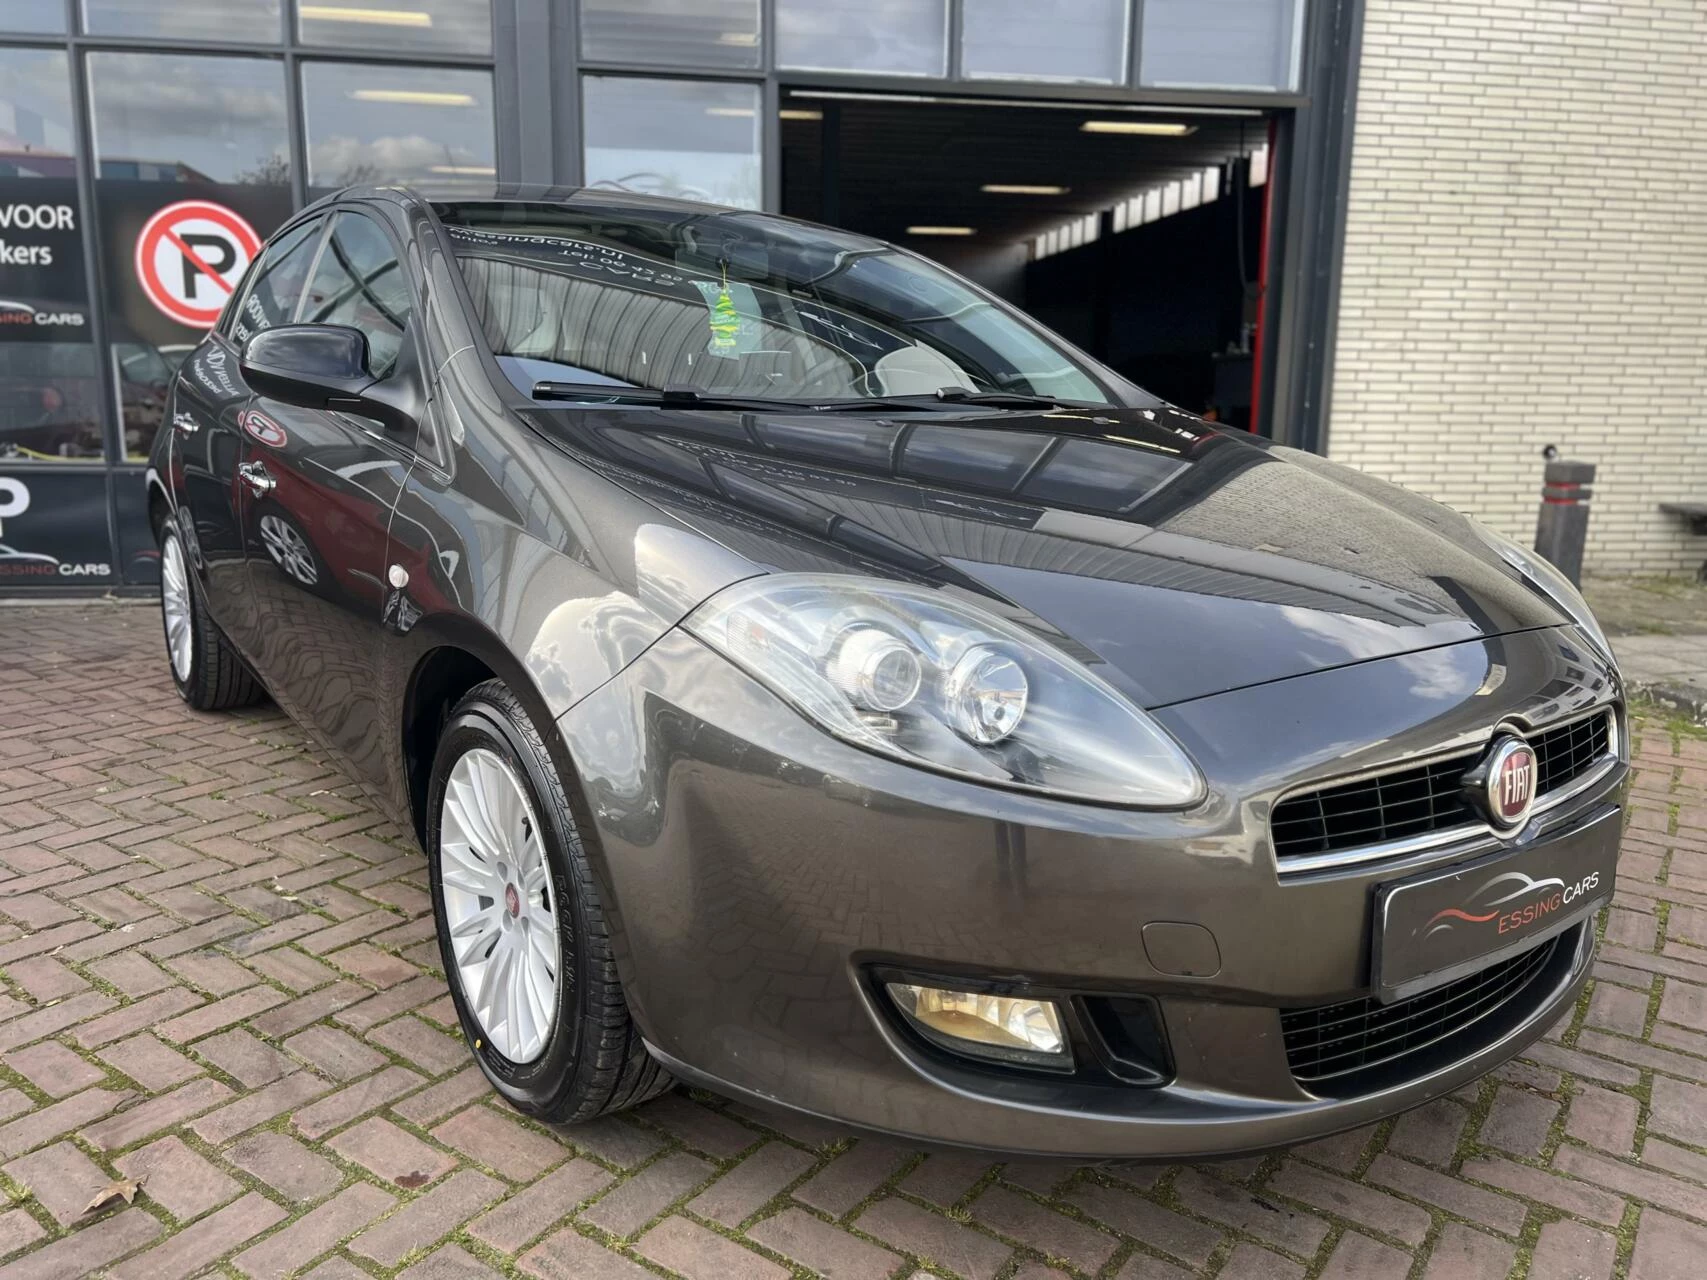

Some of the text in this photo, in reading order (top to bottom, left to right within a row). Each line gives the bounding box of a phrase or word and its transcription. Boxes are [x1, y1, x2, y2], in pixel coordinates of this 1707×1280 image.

[0, 204, 75, 230] VOOR
[34, 312, 85, 326] CARS
[59, 563, 111, 576] CARS
[1504, 764, 1530, 806] FIAT
[1498, 871, 1600, 935] ESSING CARS
